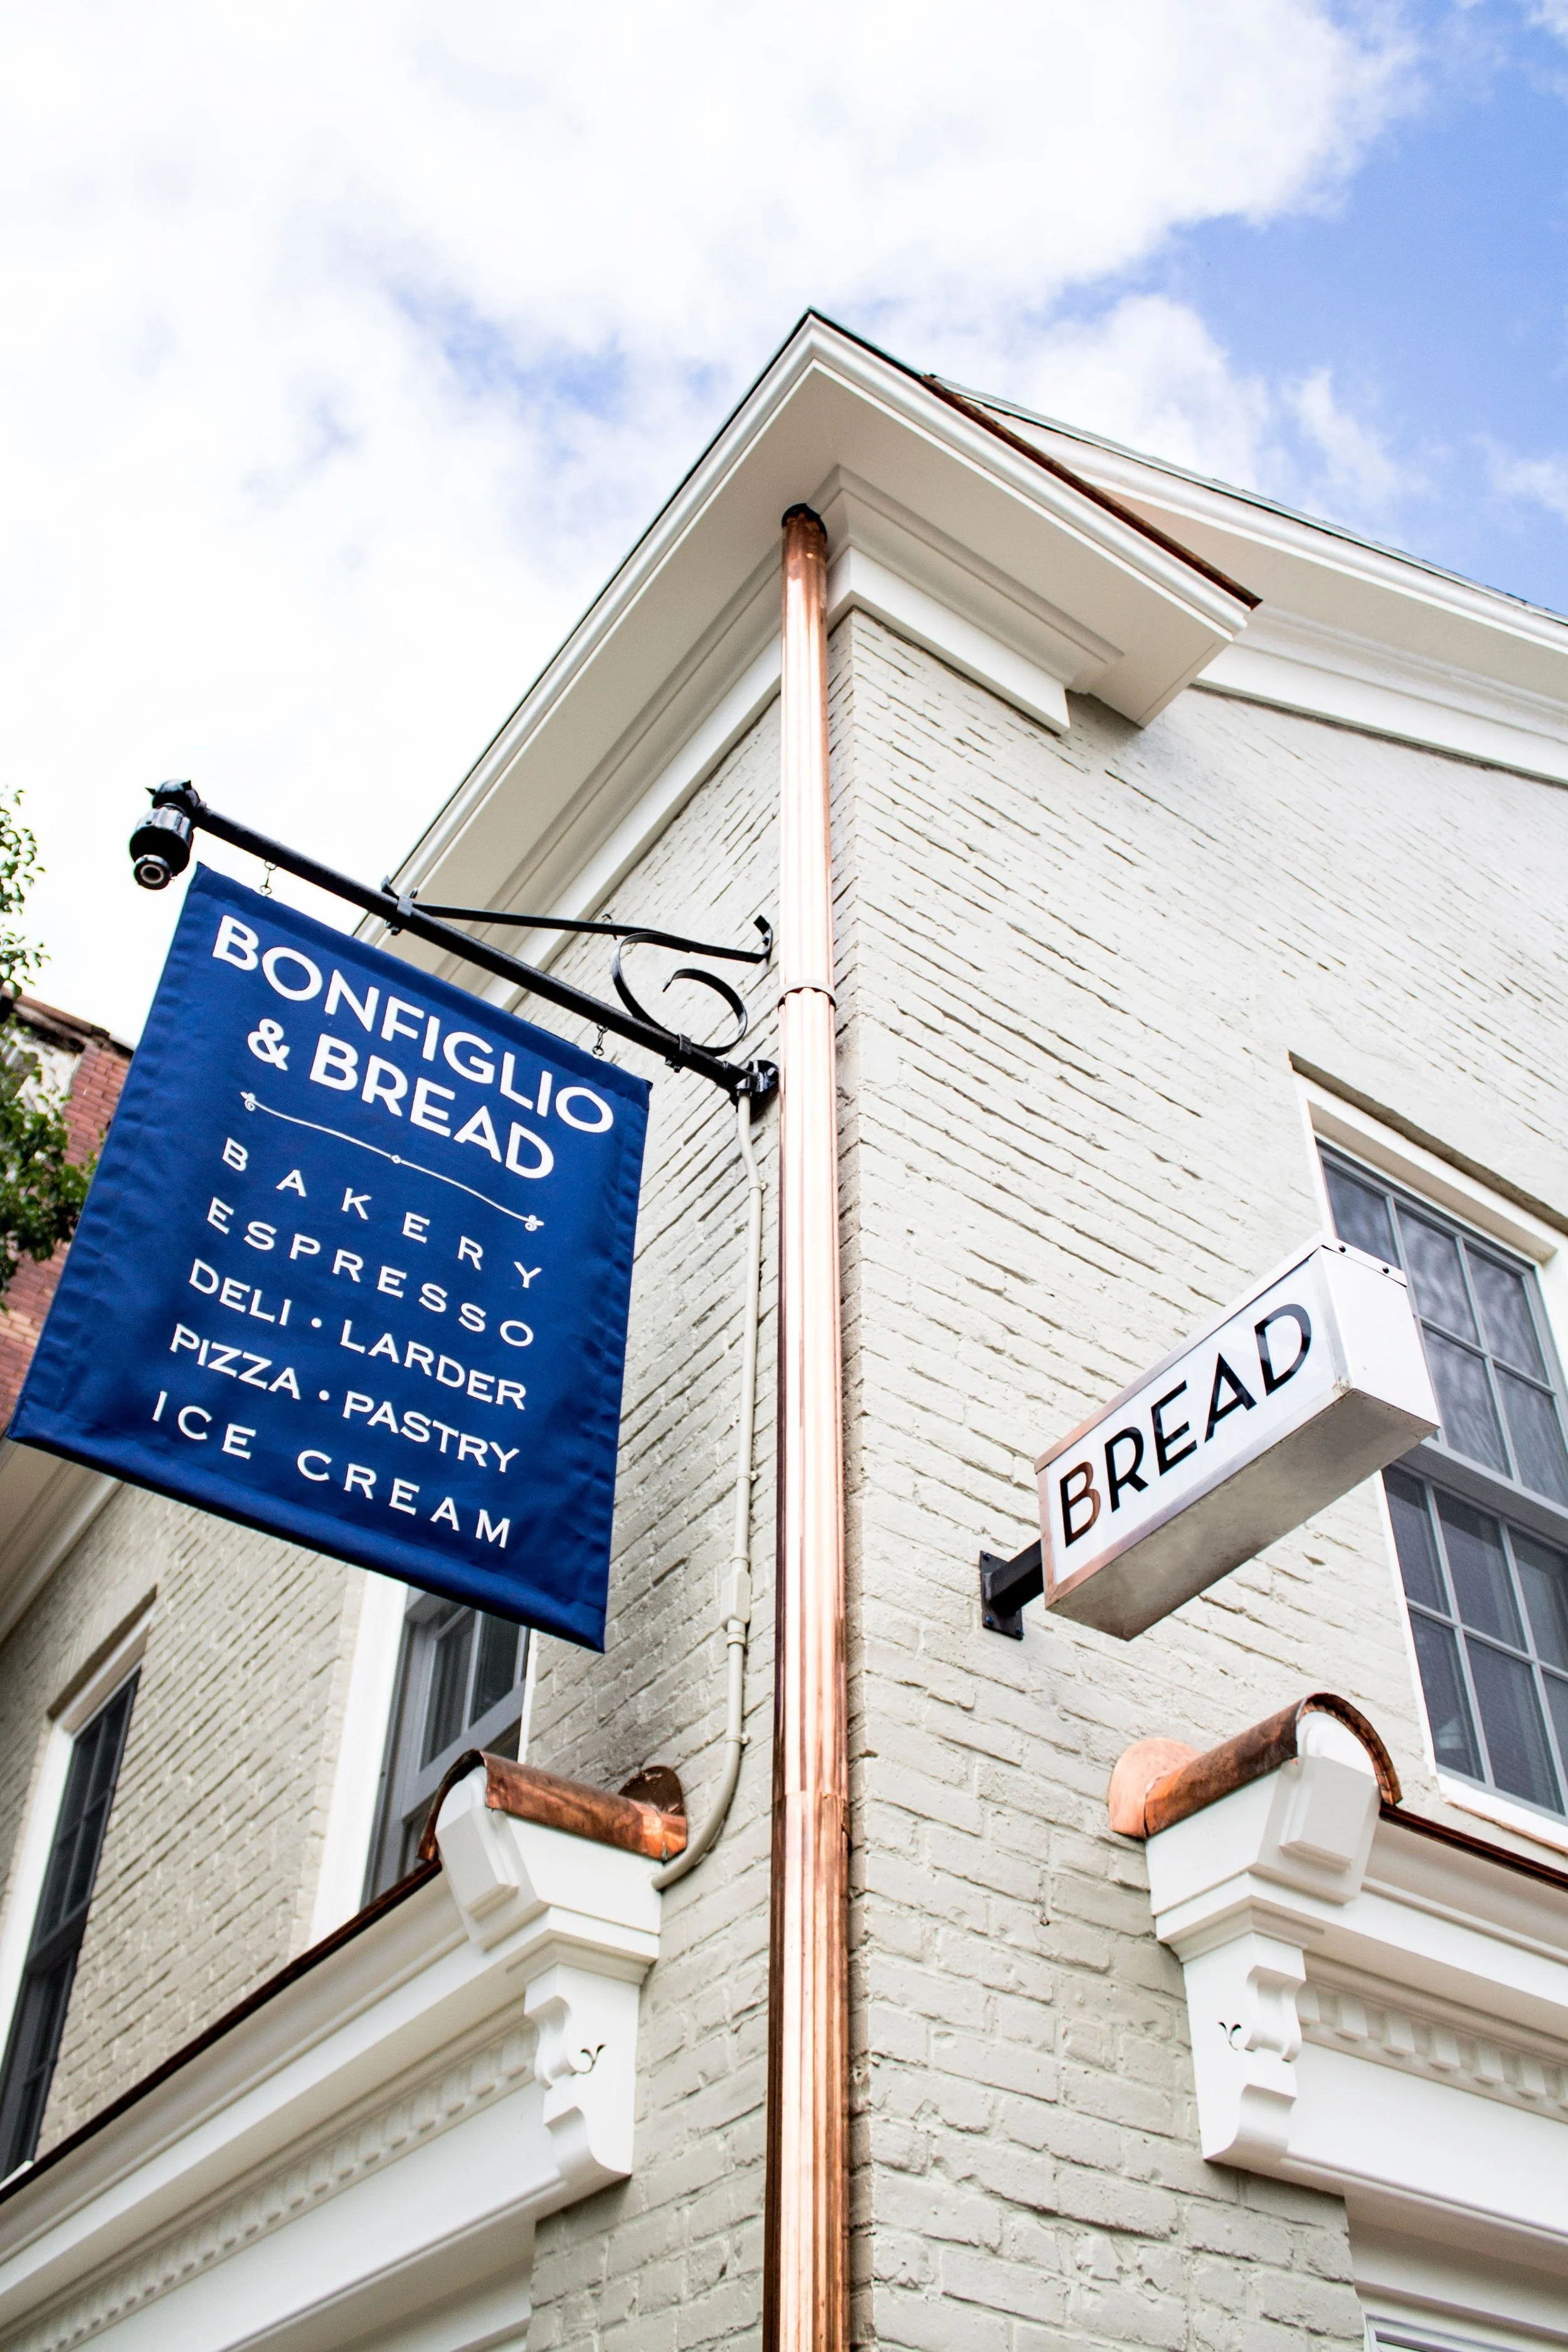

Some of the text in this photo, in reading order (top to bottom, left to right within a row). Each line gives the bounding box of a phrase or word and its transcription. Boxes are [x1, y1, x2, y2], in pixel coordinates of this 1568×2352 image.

[212, 914, 614, 1133] BONFIGLIO
[247, 1018, 554, 1179] & BREAD
[206, 1197, 534, 1347] ESPRESSO
[222, 1137, 542, 1289] BAKERY
[169, 1323, 519, 1473] PIZZA PASTRY
[188, 1258, 526, 1411] DELI LARDER
[152, 1391, 511, 1549] ICE CREAM
[1059, 1303, 1312, 1548] BREAD
